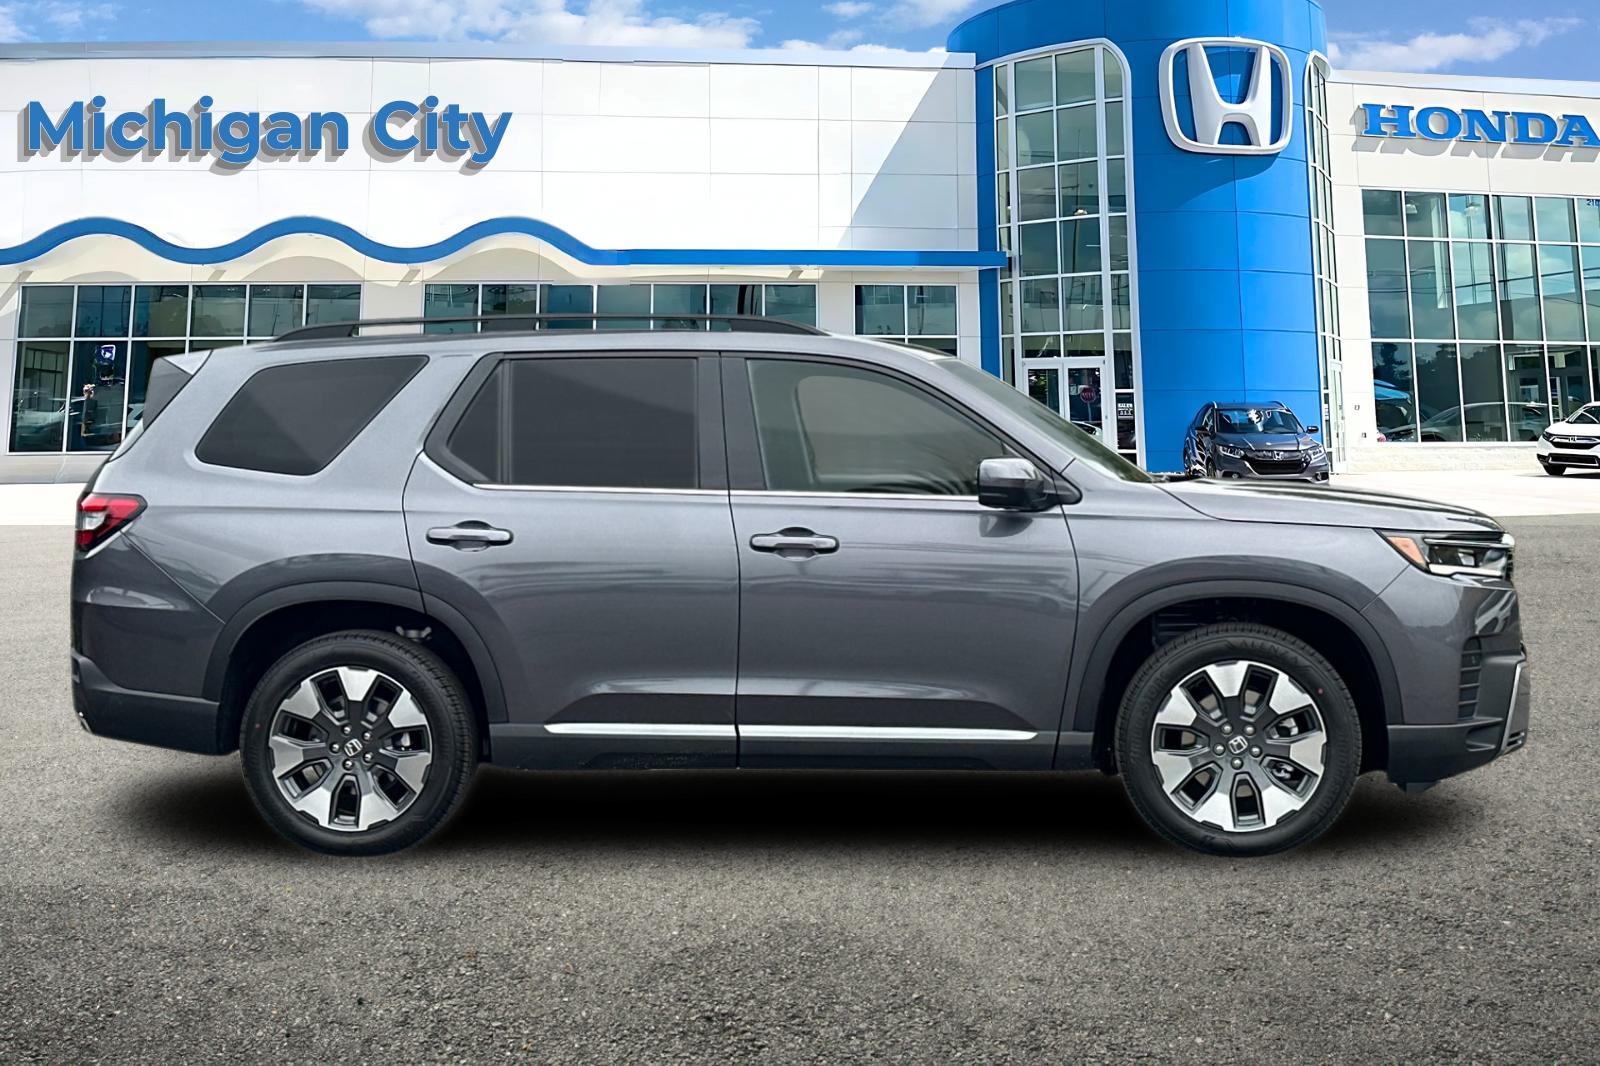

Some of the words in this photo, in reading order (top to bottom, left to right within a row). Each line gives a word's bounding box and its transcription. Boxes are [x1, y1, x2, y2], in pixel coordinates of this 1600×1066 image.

[29, 95, 349, 163] Michigan
[374, 95, 513, 163] City
[1361, 103, 1600, 146] HONDA
